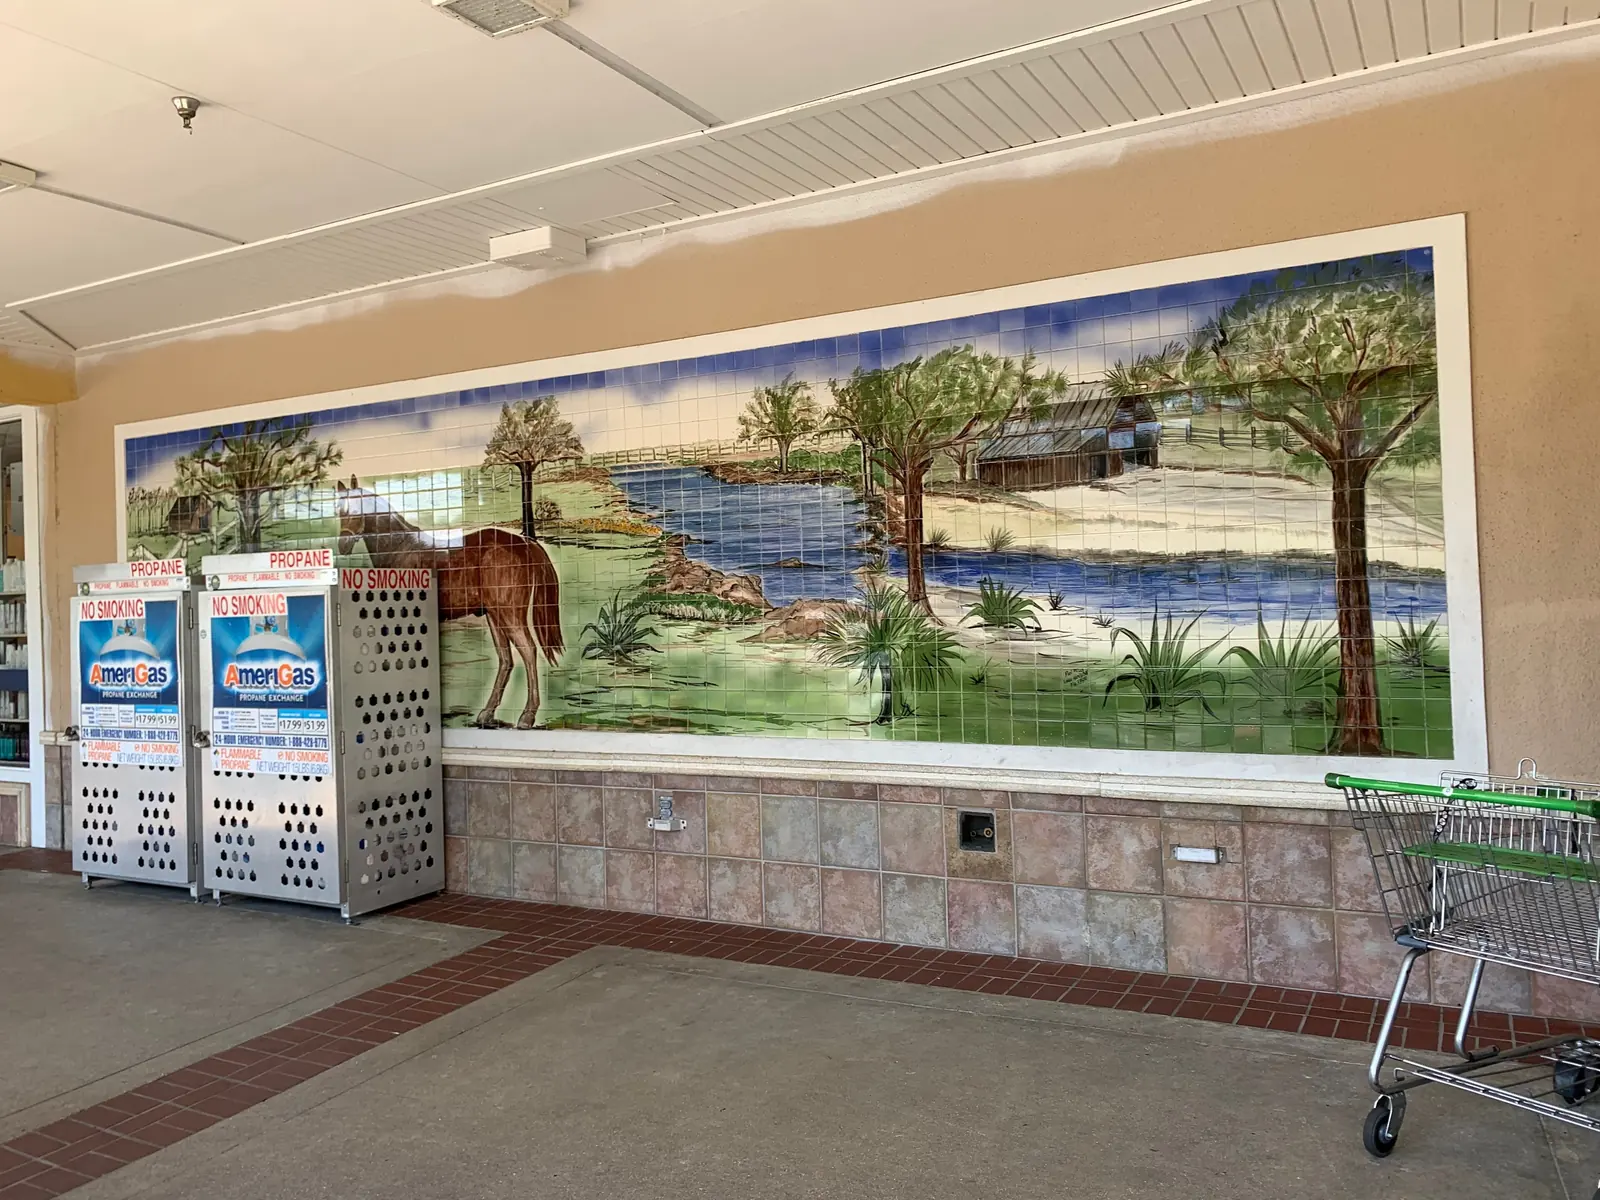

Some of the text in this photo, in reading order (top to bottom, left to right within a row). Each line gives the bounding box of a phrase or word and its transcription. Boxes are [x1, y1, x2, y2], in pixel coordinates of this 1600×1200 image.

[270, 550, 331, 569] PROPANE
[131, 559, 183, 577] PROPANE
[228, 571, 315, 582] PROPANE FLAMMABLE NO SMOKING
[342, 568, 430, 589] NO SMOKING
[81, 598, 144, 620] NO SMOKING
[212, 594, 286, 616] NO SMOKING
[90, 663, 168, 685] AmeriGas
[224, 663, 316, 687] AmeriGas
[102, 691, 158, 699] PROPANE EXCHANGE
[239, 693, 304, 702] PROPANE EXCHANGE
[88, 740, 179, 755] FLAMMABLE NO SMOKING
[88, 751, 113, 762] PROPANE
[221, 749, 329, 763] FLAMMABLE NO SMOKING
[221, 759, 251, 771] PROPANE
